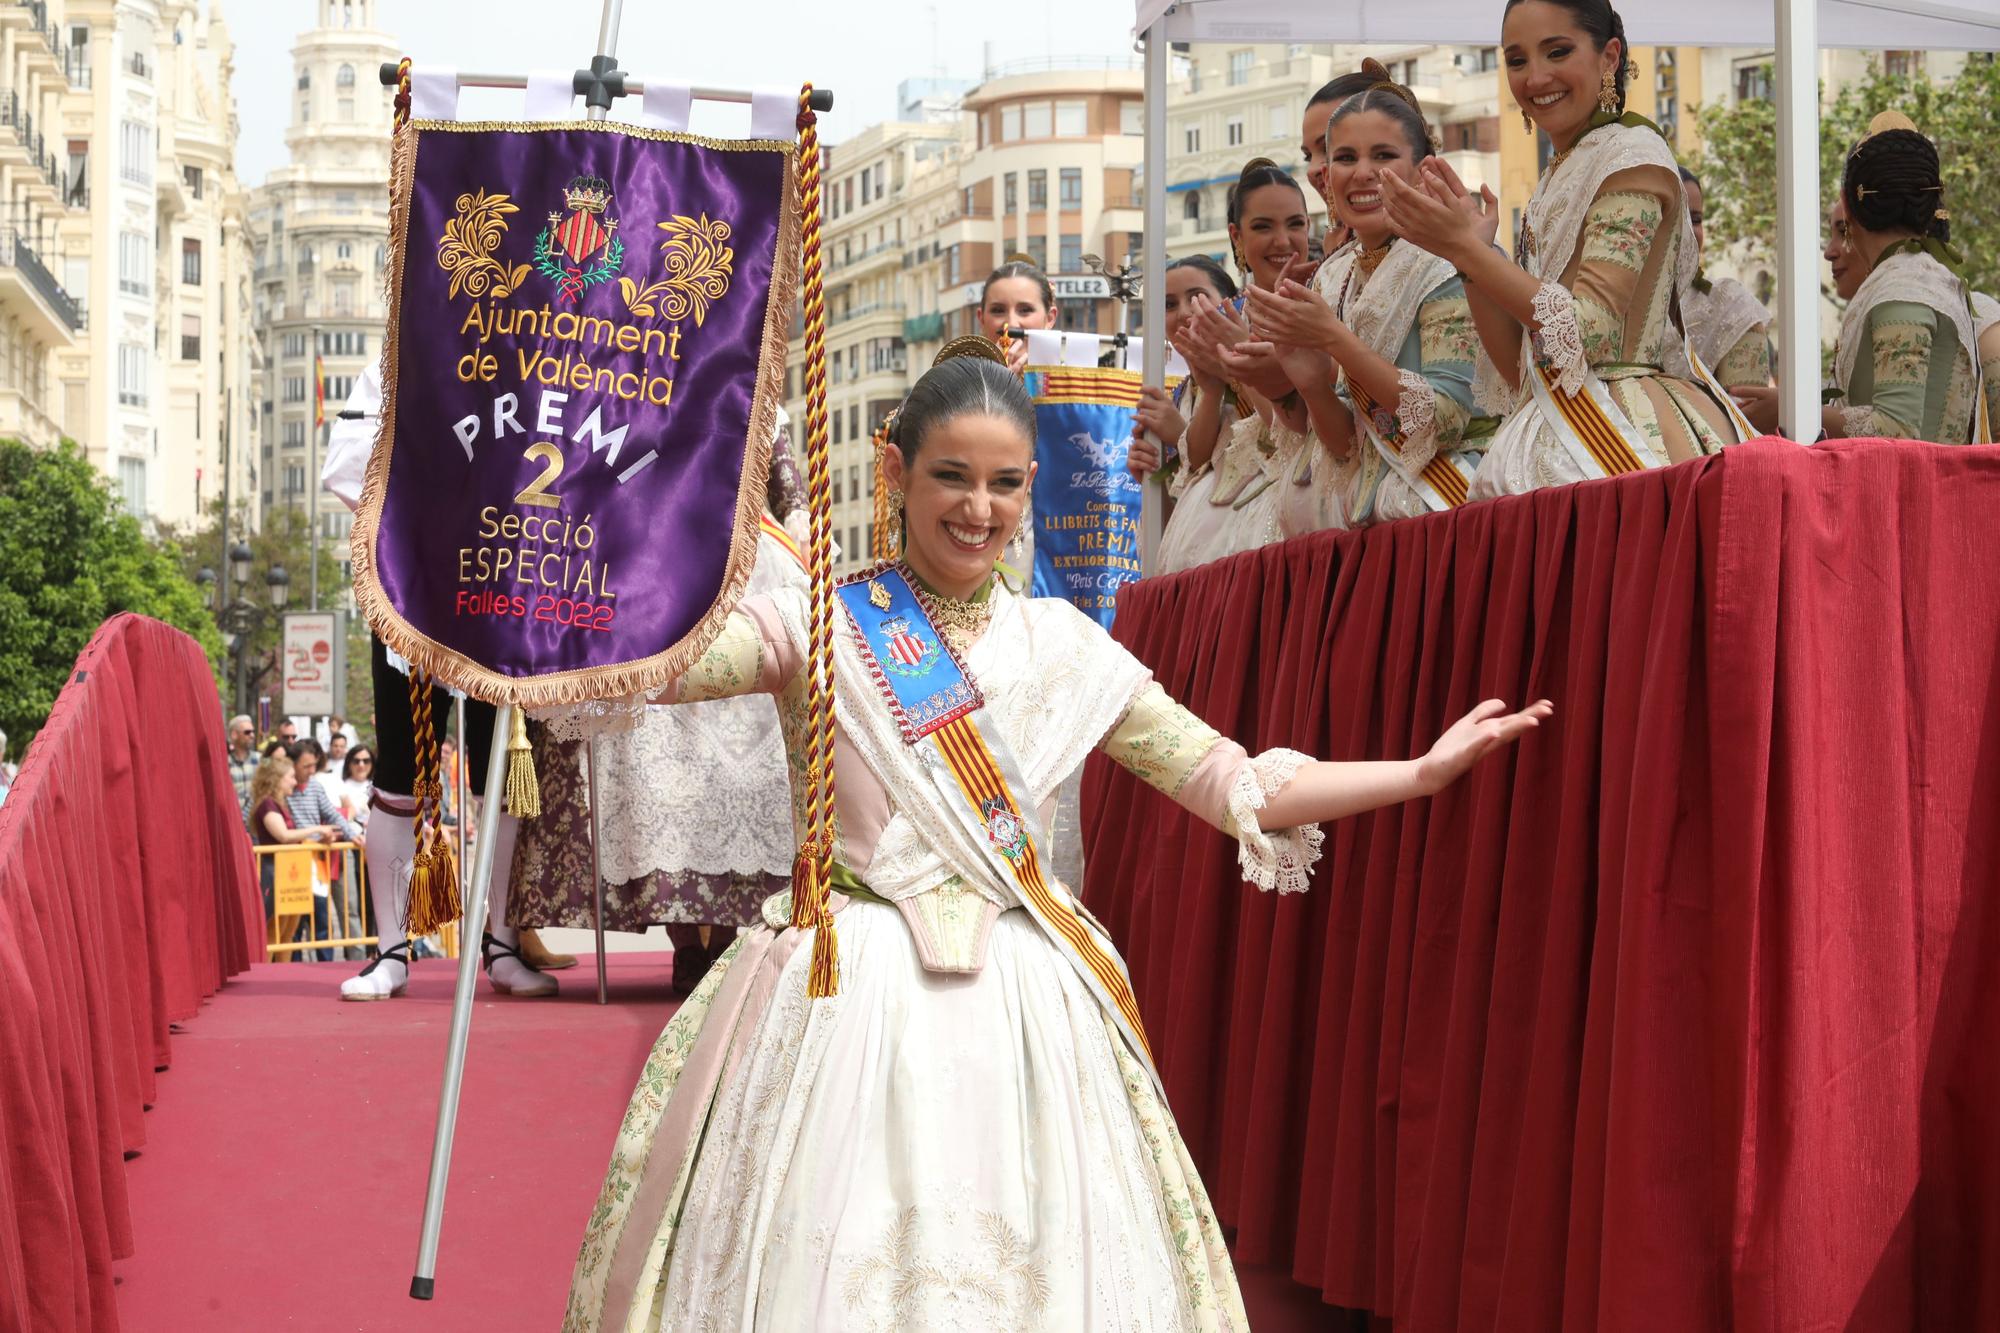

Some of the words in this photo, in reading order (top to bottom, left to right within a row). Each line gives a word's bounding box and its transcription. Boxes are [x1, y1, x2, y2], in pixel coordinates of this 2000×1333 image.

[460, 301, 682, 361] Ajuntament
[457, 348, 498, 382] de
[518, 348, 673, 406] València
[452, 390, 659, 485] PREMI
[514, 442, 564, 509] 2
[1045, 514, 1100, 530] LLIBRETS
[1104, 515, 1118, 529] de
[1121, 517, 1138, 533] FA
[1086, 500, 1127, 513] Concurs
[479, 506, 594, 550] Secció
[1079, 531, 1131, 555] PREMI
[459, 547, 616, 598] ESPECIAL
[1053, 554, 1141, 572] EXTRAORDINA
[1096, 572, 1135, 590] Cel
[456, 591, 526, 616] Falles
[535, 594, 614, 631] 2022
[1096, 594, 1115, 608] 20
